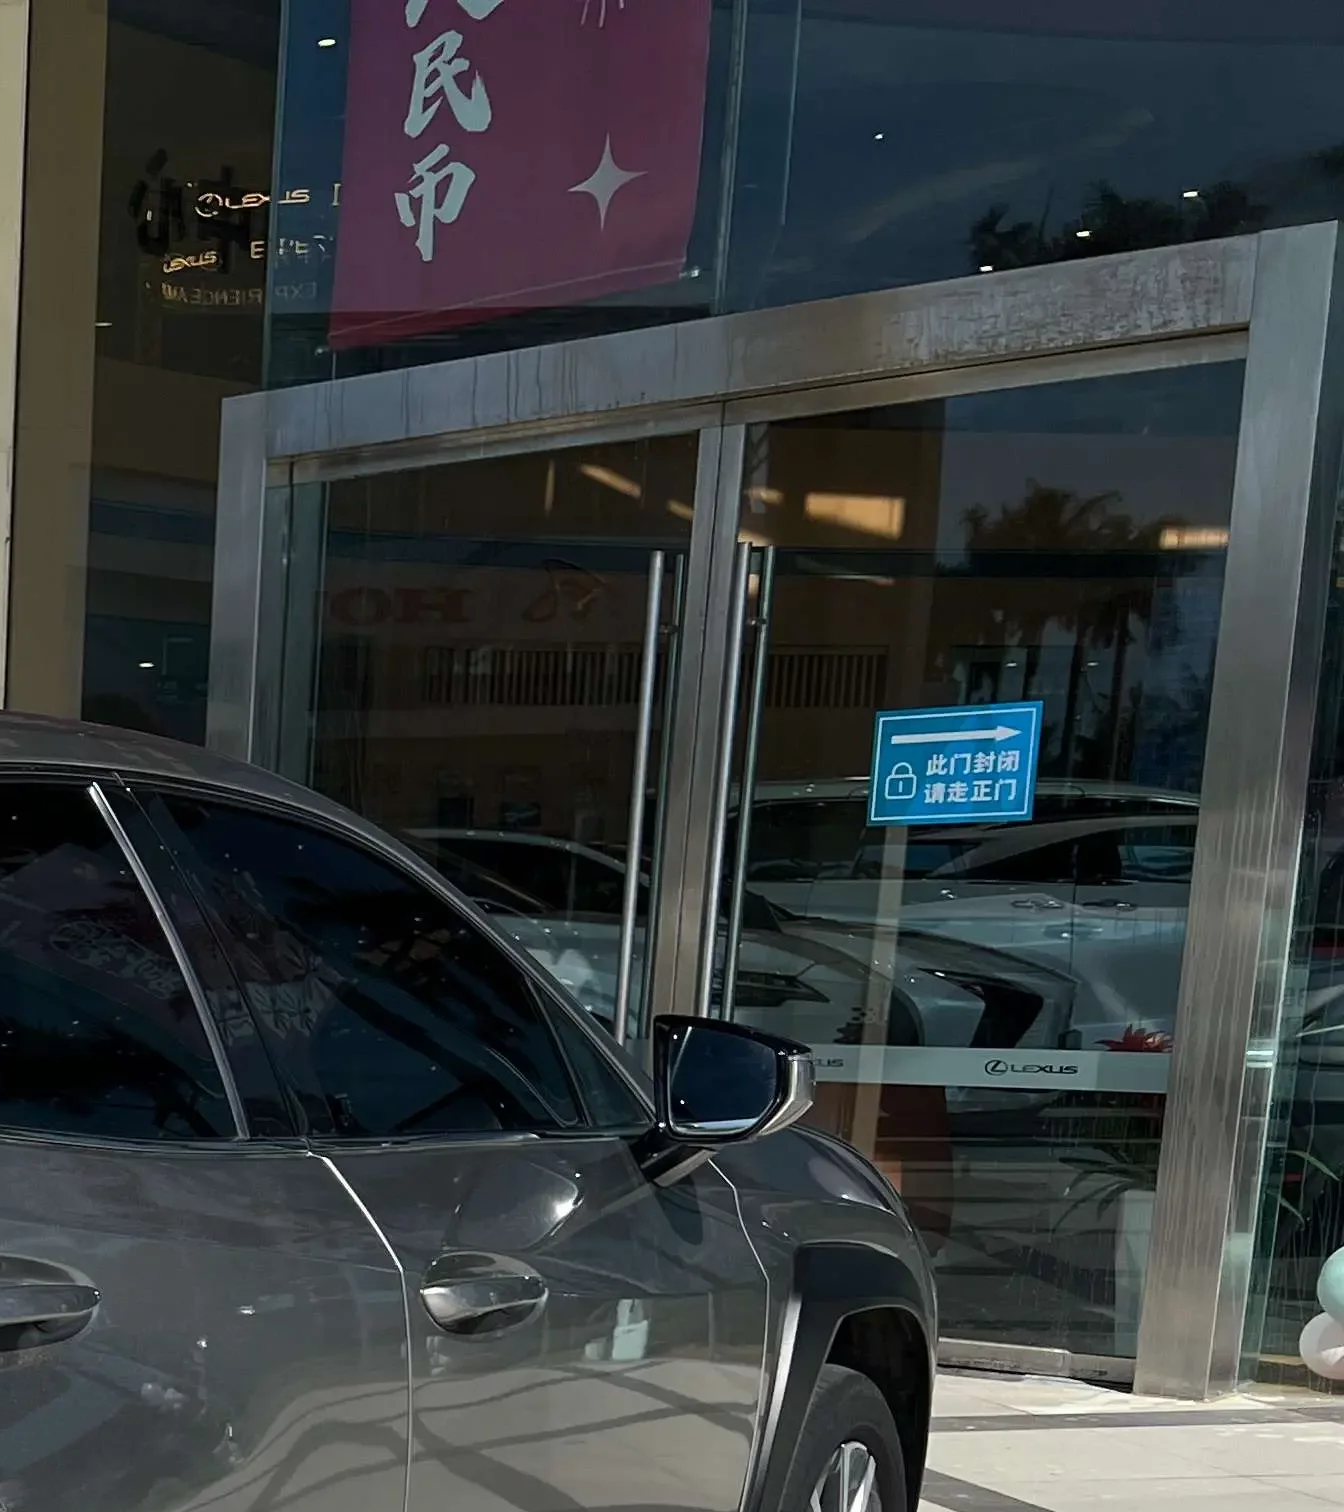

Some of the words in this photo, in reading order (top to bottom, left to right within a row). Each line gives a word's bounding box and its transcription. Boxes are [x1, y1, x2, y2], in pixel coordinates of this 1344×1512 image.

[393, 0, 505, 262] 民币
[926, 750, 1021, 777] 此门封闭
[924, 778, 1017, 804] 请走正门
[1010, 1063, 1079, 1075] LEXUS
